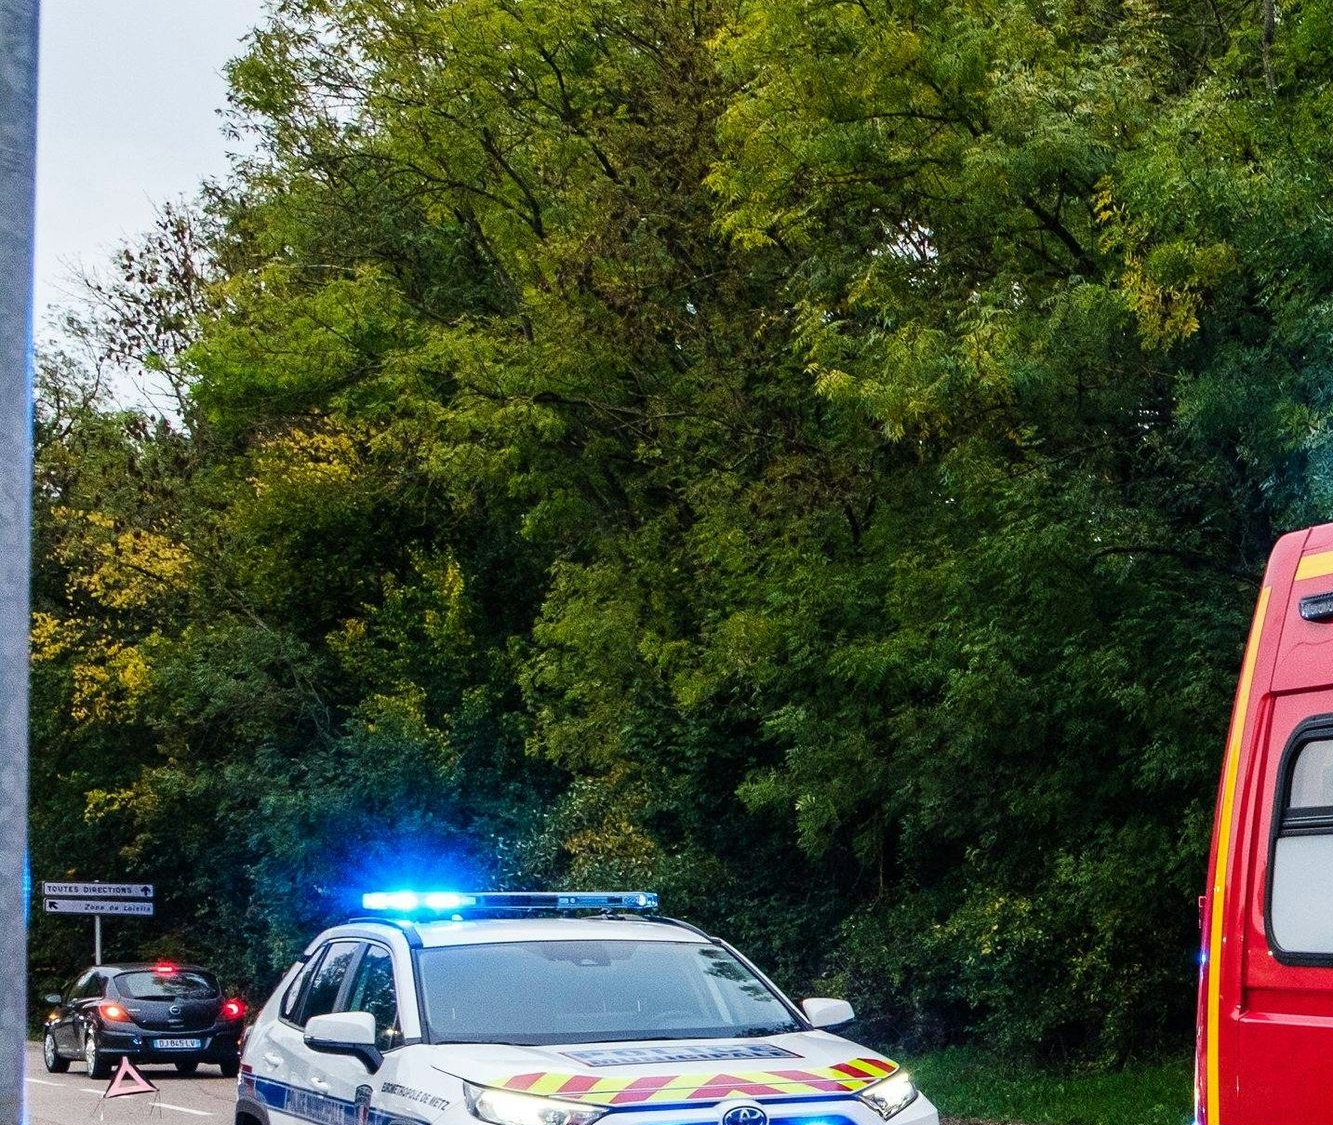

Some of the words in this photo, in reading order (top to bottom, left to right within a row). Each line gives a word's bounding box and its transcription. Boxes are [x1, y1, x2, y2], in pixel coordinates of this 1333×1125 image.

[47, 885, 79, 893] TOUTES
[83, 886, 132, 894] DIRECTIONS
[587, 1051, 791, 1065] MUNICIPALE
[428, 1096, 450, 1111] METZ
